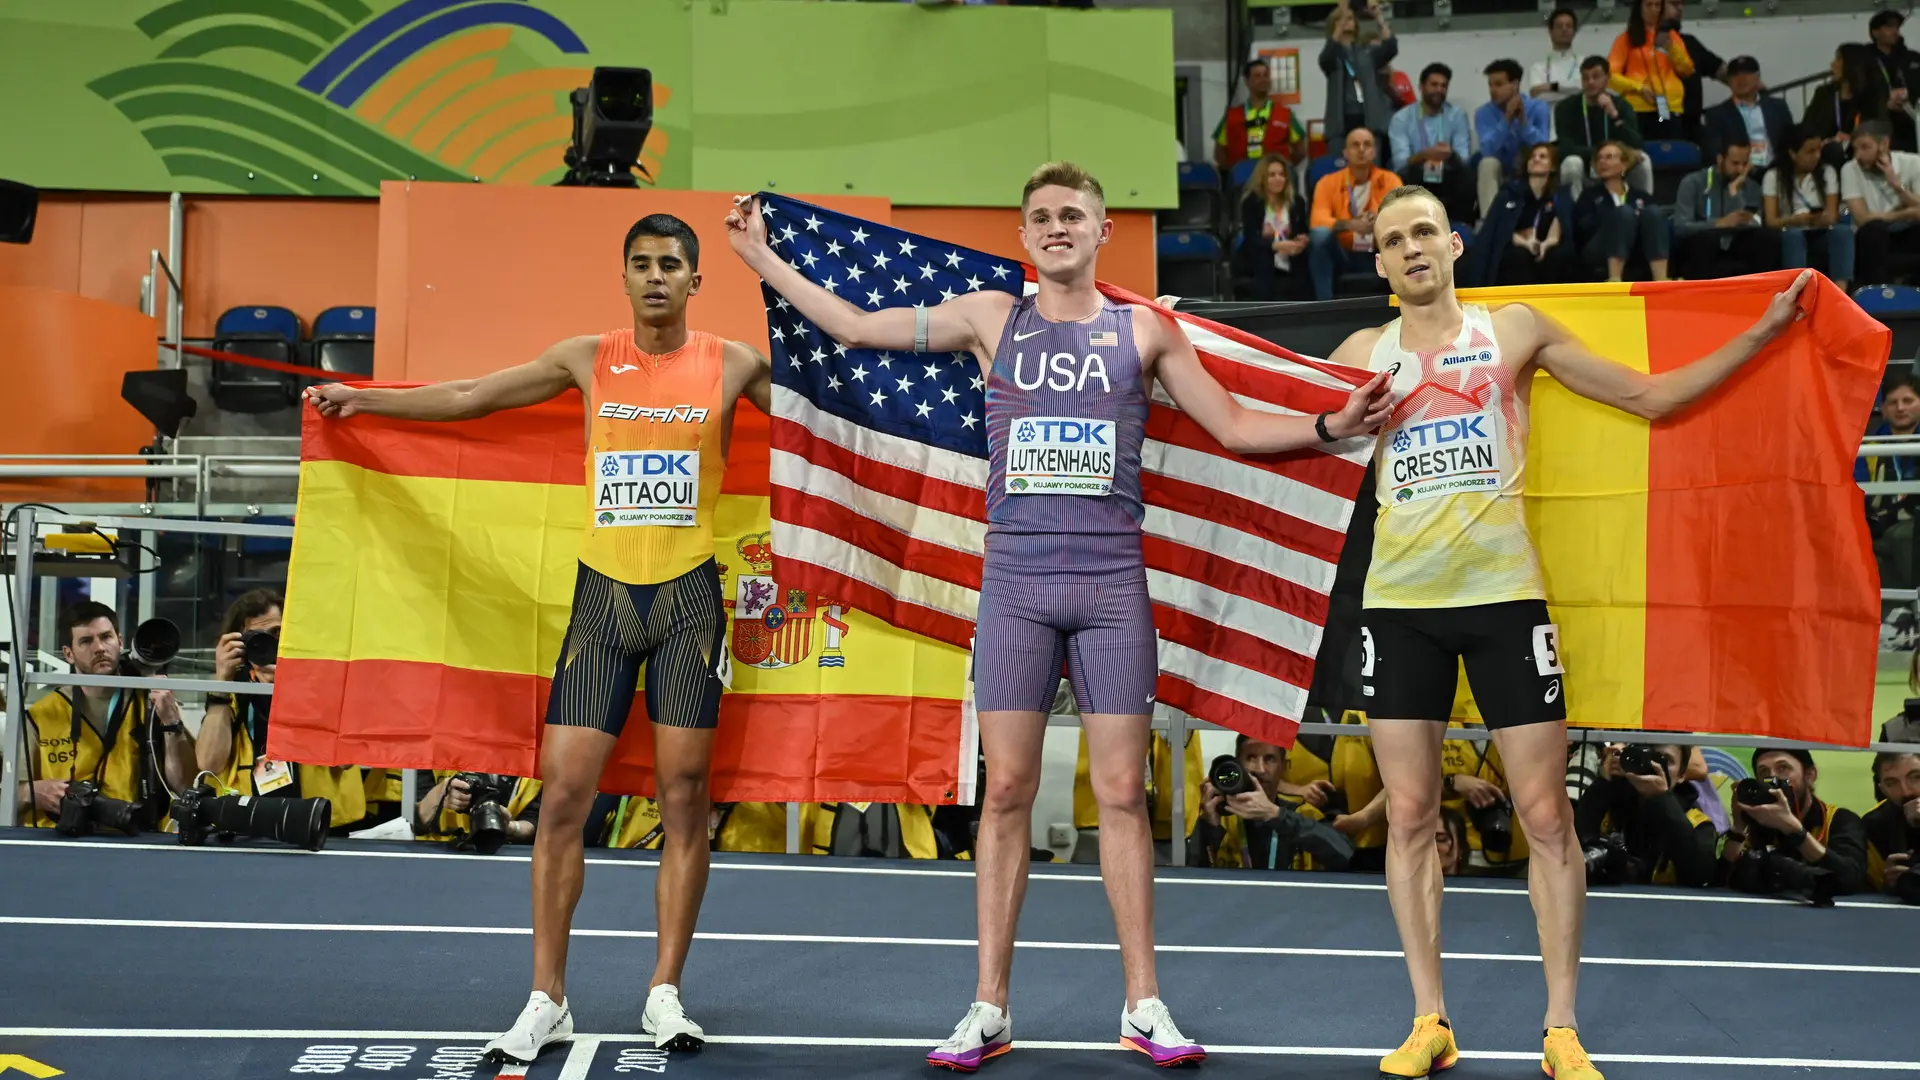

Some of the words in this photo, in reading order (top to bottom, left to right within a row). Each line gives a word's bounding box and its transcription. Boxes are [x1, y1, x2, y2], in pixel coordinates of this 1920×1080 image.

[1014, 351, 1110, 393] USA
[1442, 354, 1477, 366] Allianz
[598, 402, 709, 424] ESPAÑA
[1035, 420, 1108, 445] TDK
[1410, 415, 1488, 447] TDK
[618, 453, 692, 476] TDK
[1010, 448, 1111, 475] LUTKENHAUS
[1393, 444, 1493, 483] CRESTAN
[599, 481, 693, 506] ATTAOUI
[1033, 482, 1064, 490] KUJAWY
[1064, 482, 1101, 490] POMORZE
[1417, 484, 1447, 495] KUJAWY
[1449, 479, 1486, 489] POMORZE
[1486, 477, 1496, 485] 26
[619, 513, 648, 521] KUJAWY
[649, 513, 684, 521] POMORZE
[1544, 632, 1558, 668] 5
[40, 736, 71, 747] SON
[289, 1045, 359, 1073] 800
[354, 1045, 417, 1071] 400
[416, 1046, 488, 1080] x400
[614, 1048, 670, 1073] 200
